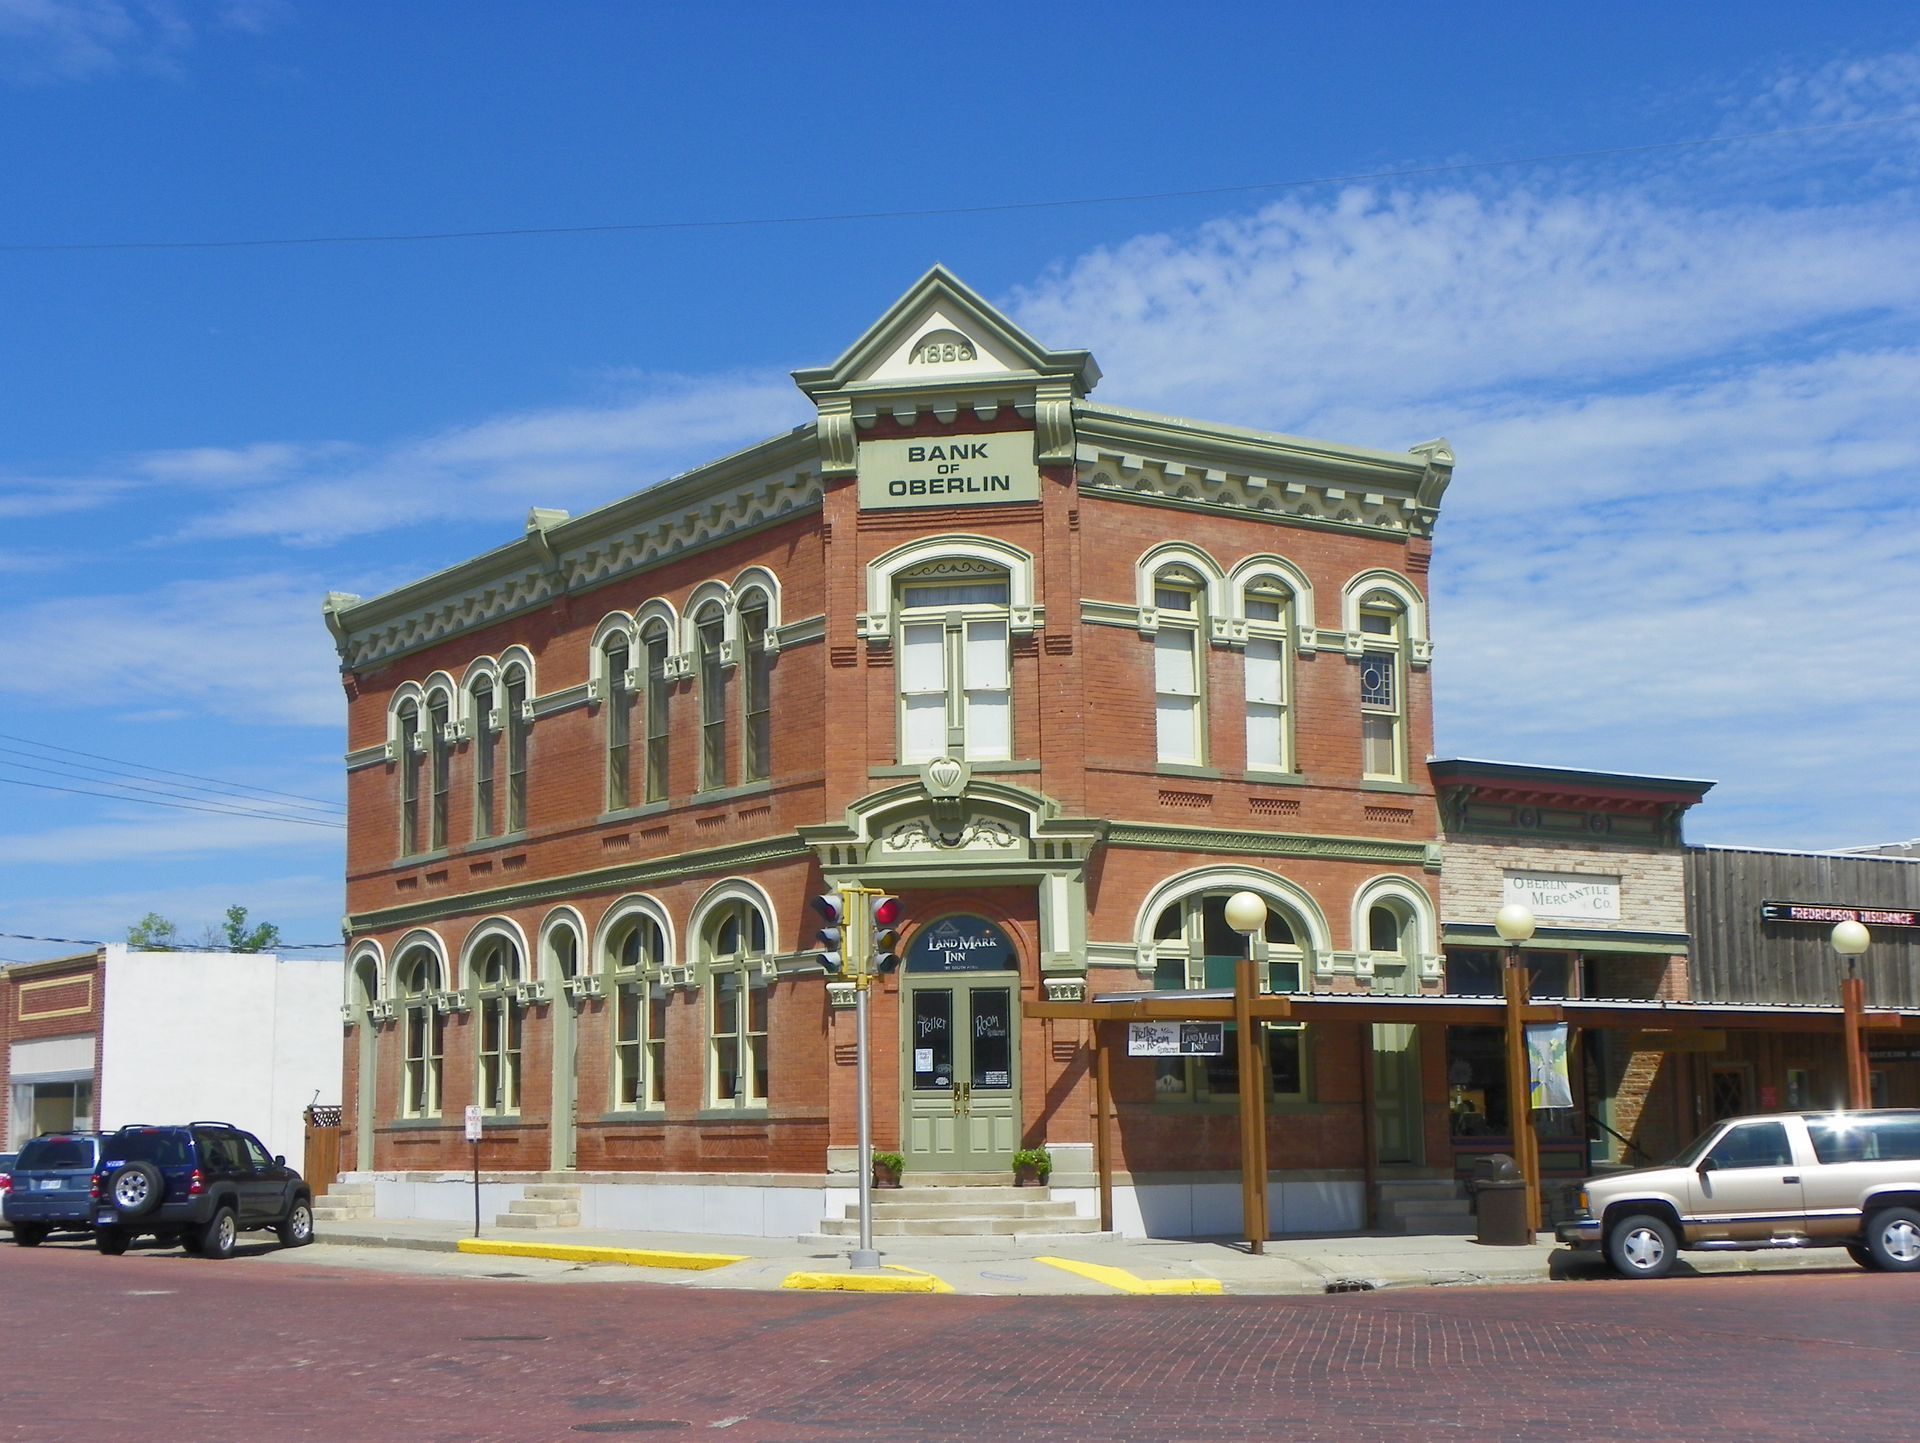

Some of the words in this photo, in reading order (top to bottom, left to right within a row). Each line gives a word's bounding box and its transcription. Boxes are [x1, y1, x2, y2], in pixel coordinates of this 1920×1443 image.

[908, 443, 988, 462] BANK
[937, 464, 959, 474] OF
[889, 475, 1010, 496] OBERLIN
[1531, 885, 1610, 906] MERCANTILE
[1790, 907, 1857, 921] FREDRICKSON
[1860, 911, 1915, 925] INSURANCE
[945, 951, 966, 965] INN
[917, 1016, 947, 1038] Teller
[1131, 1026, 1157, 1043] Teller
[1191, 1042, 1204, 1052] INN
